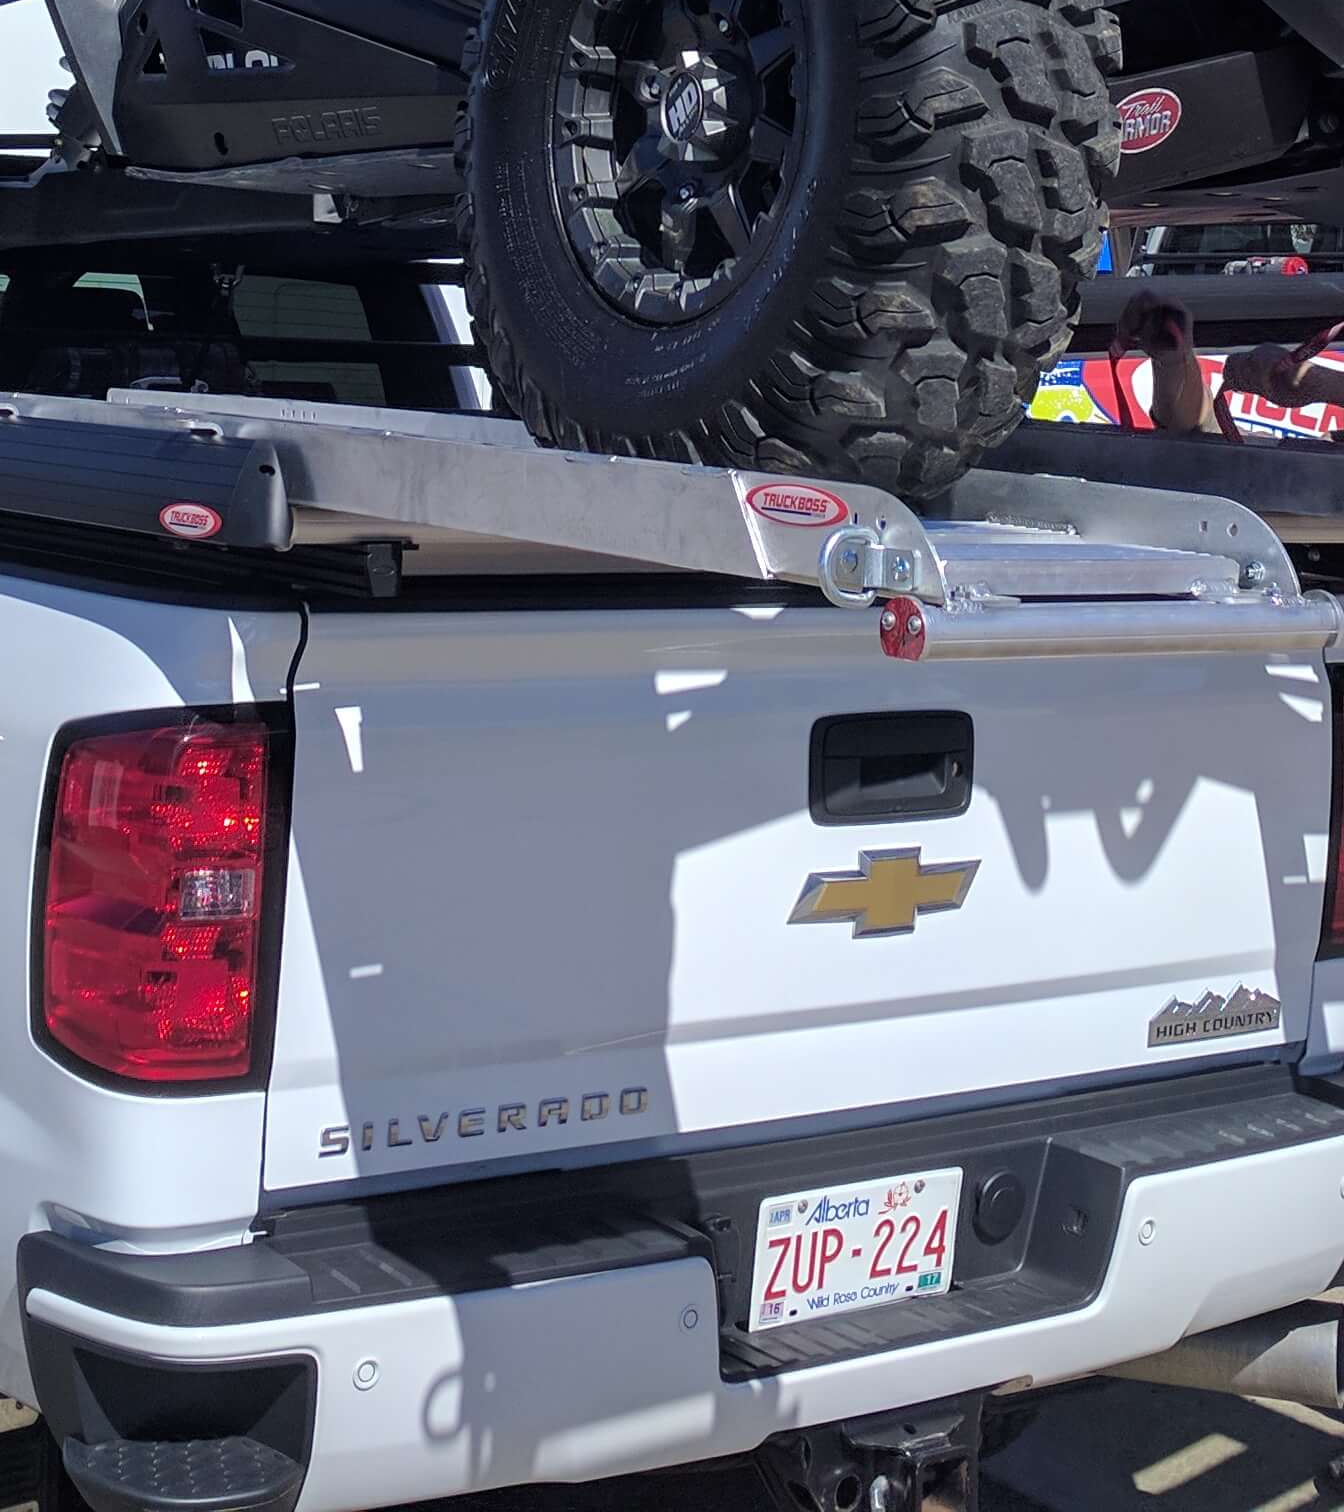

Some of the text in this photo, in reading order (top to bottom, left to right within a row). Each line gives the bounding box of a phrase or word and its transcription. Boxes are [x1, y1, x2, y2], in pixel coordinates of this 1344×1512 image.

[1121, 95, 1166, 121] Trail
[272, 106, 382, 145] POLARIS
[1122, 109, 1173, 142] RMOR
[763, 492, 826, 513] TRUCKBOSS
[1156, 1011, 1274, 1039] HIGH COUNTRY
[318, 1086, 649, 1159] SILVERADO
[805, 1195, 871, 1226] Alberta
[807, 1282, 900, 1311] Wild Rose Country
